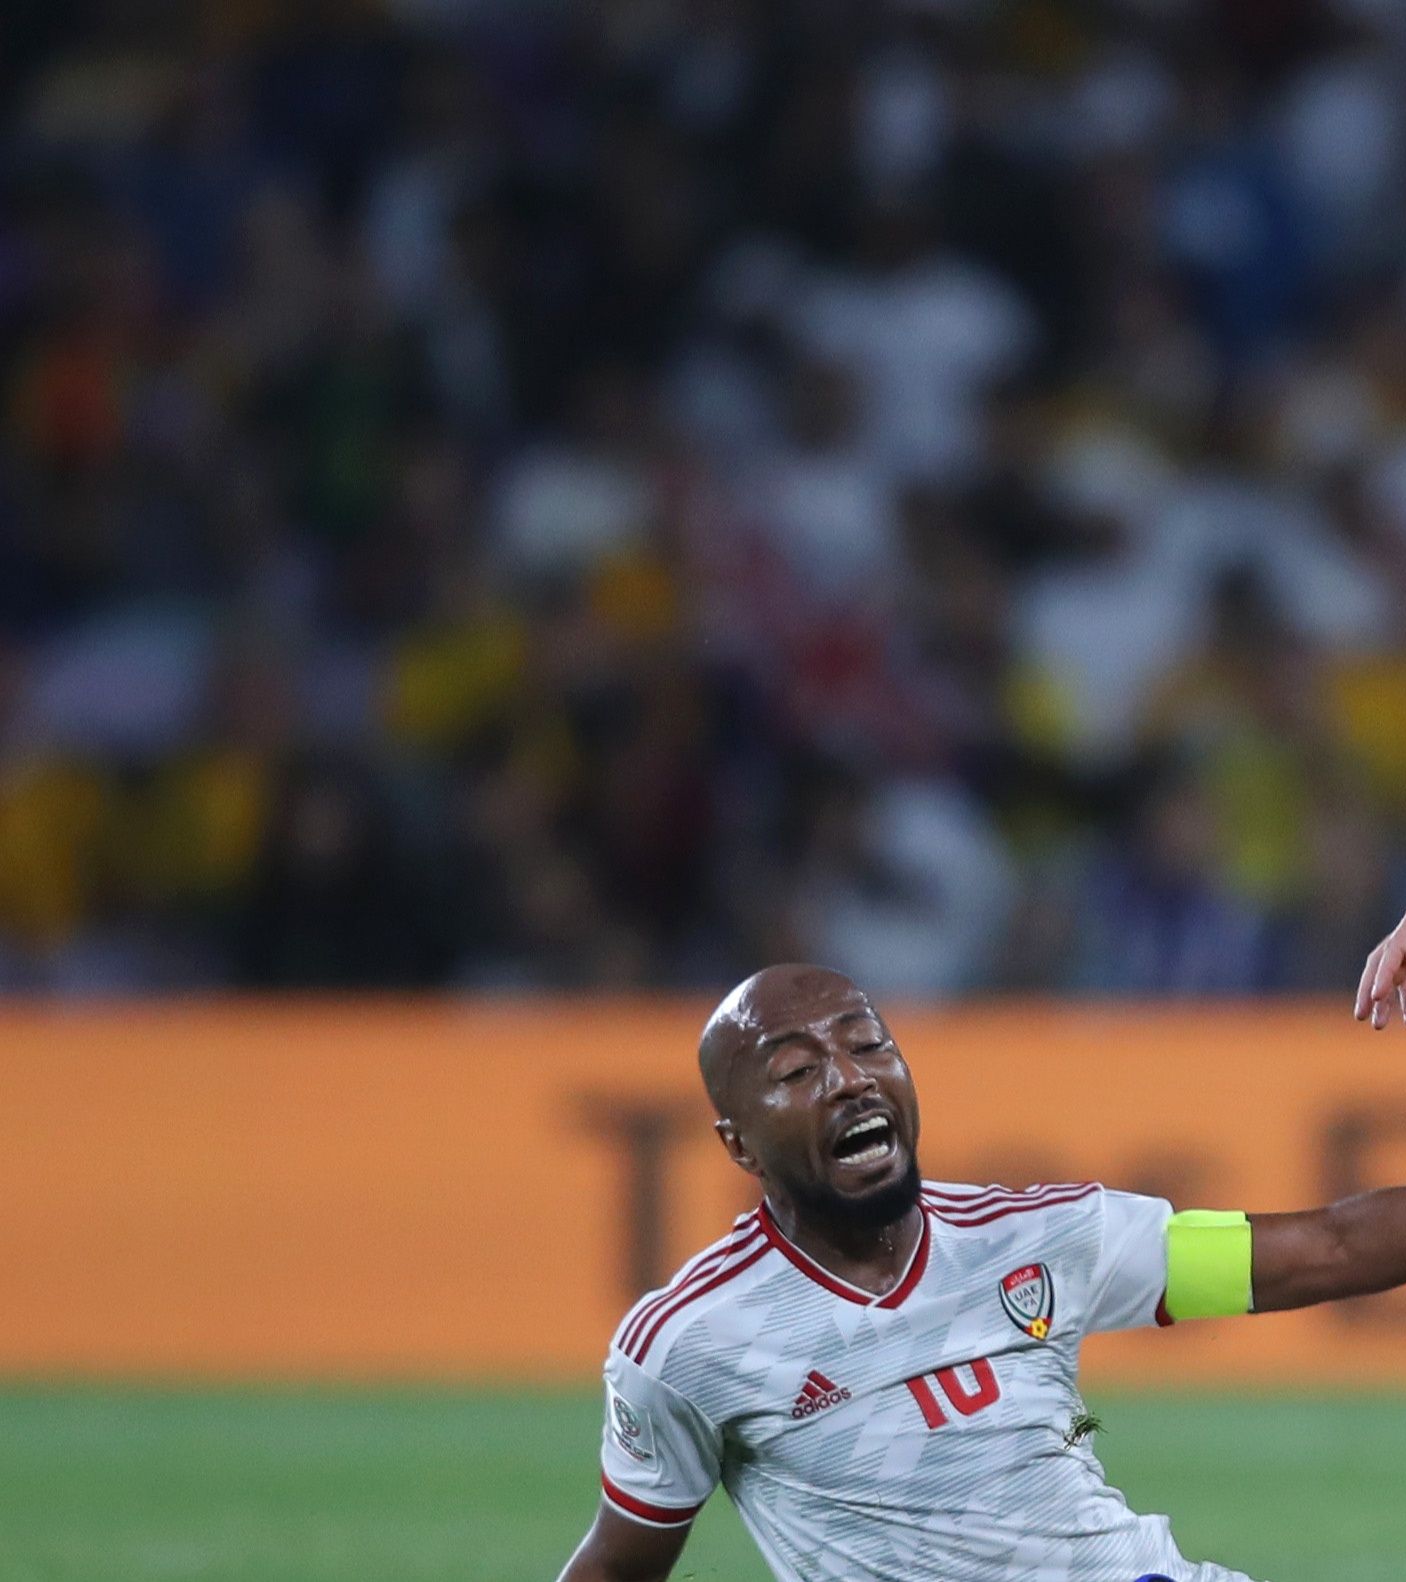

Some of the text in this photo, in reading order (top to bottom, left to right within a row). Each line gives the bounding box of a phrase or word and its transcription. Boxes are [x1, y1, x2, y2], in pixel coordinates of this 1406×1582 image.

[1014, 1284, 1039, 1301] UAE
[791, 1387, 852, 1420] adidas
[905, 1357, 1001, 1430] 10
